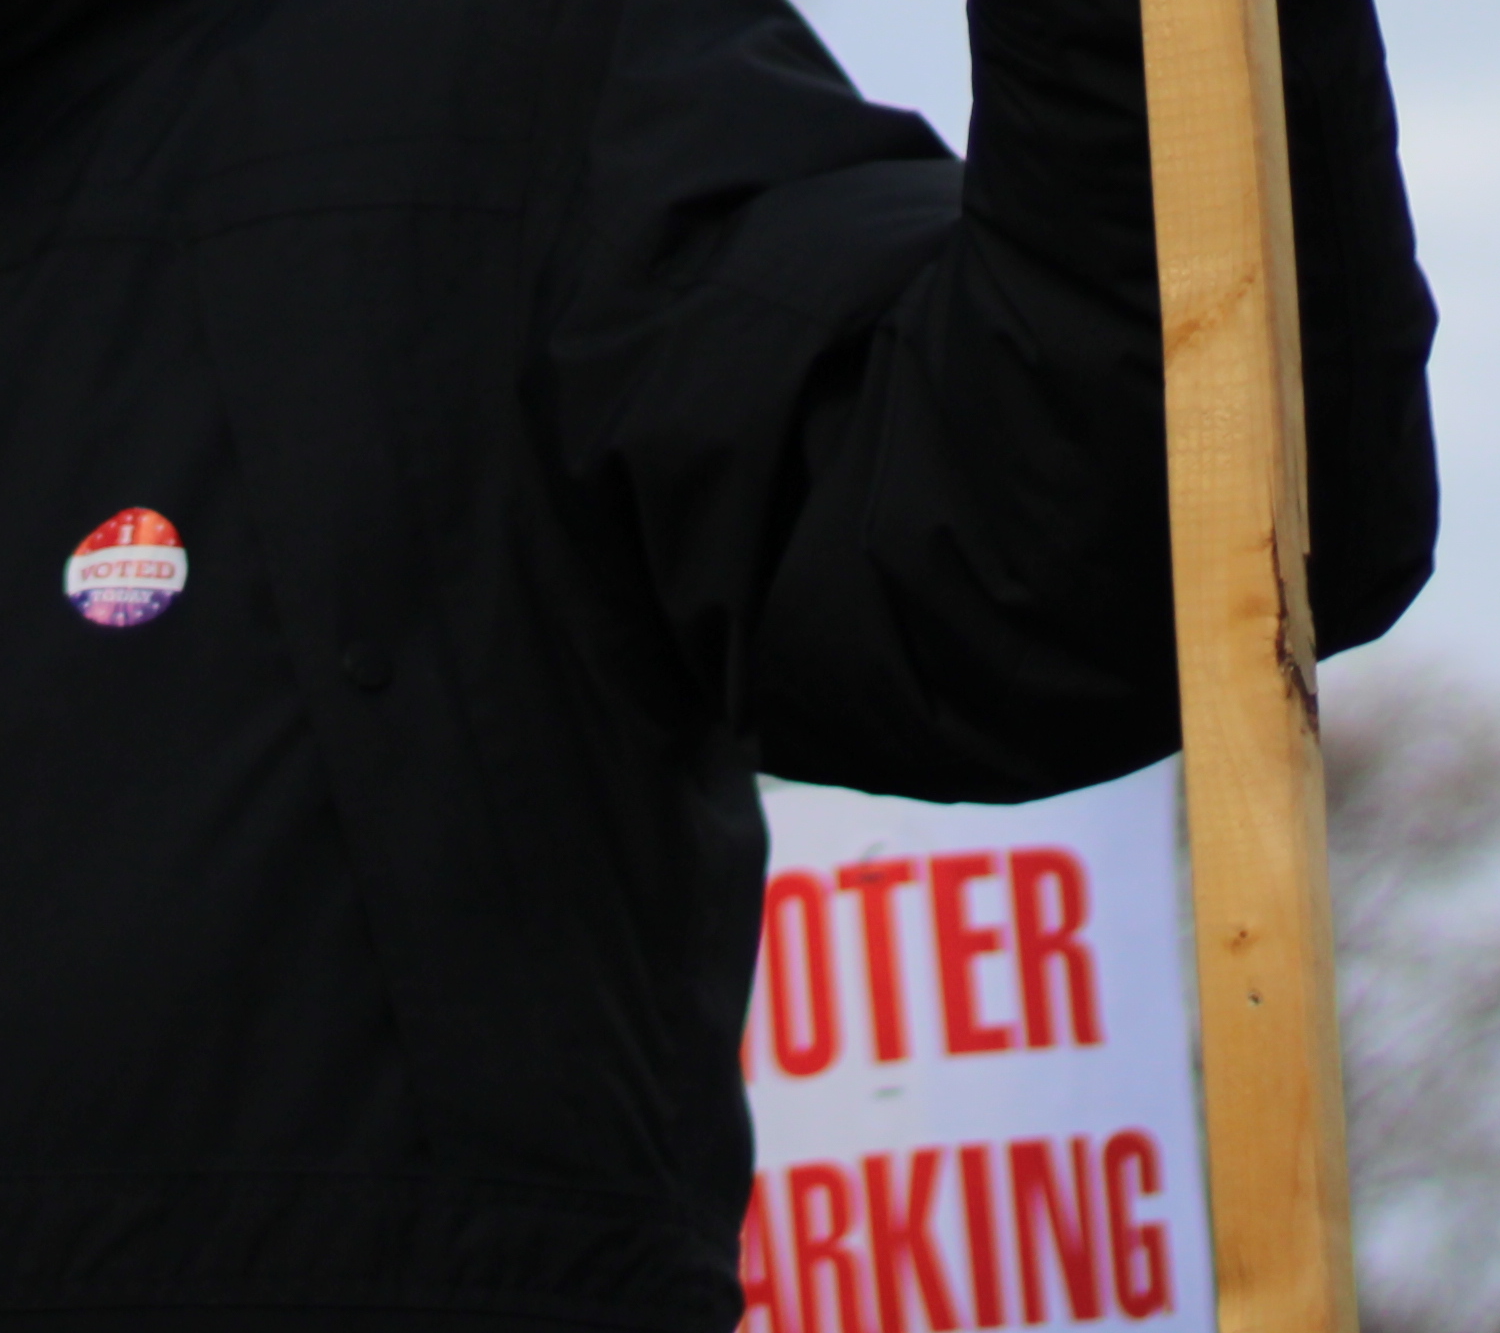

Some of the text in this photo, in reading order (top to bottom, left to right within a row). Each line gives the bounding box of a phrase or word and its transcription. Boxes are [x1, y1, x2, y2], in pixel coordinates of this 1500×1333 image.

[81, 559, 177, 581] VOTED
[118, 523, 135, 546] I
[740, 845, 1105, 1083] OTER
[735, 1127, 1174, 1333] ARKING
